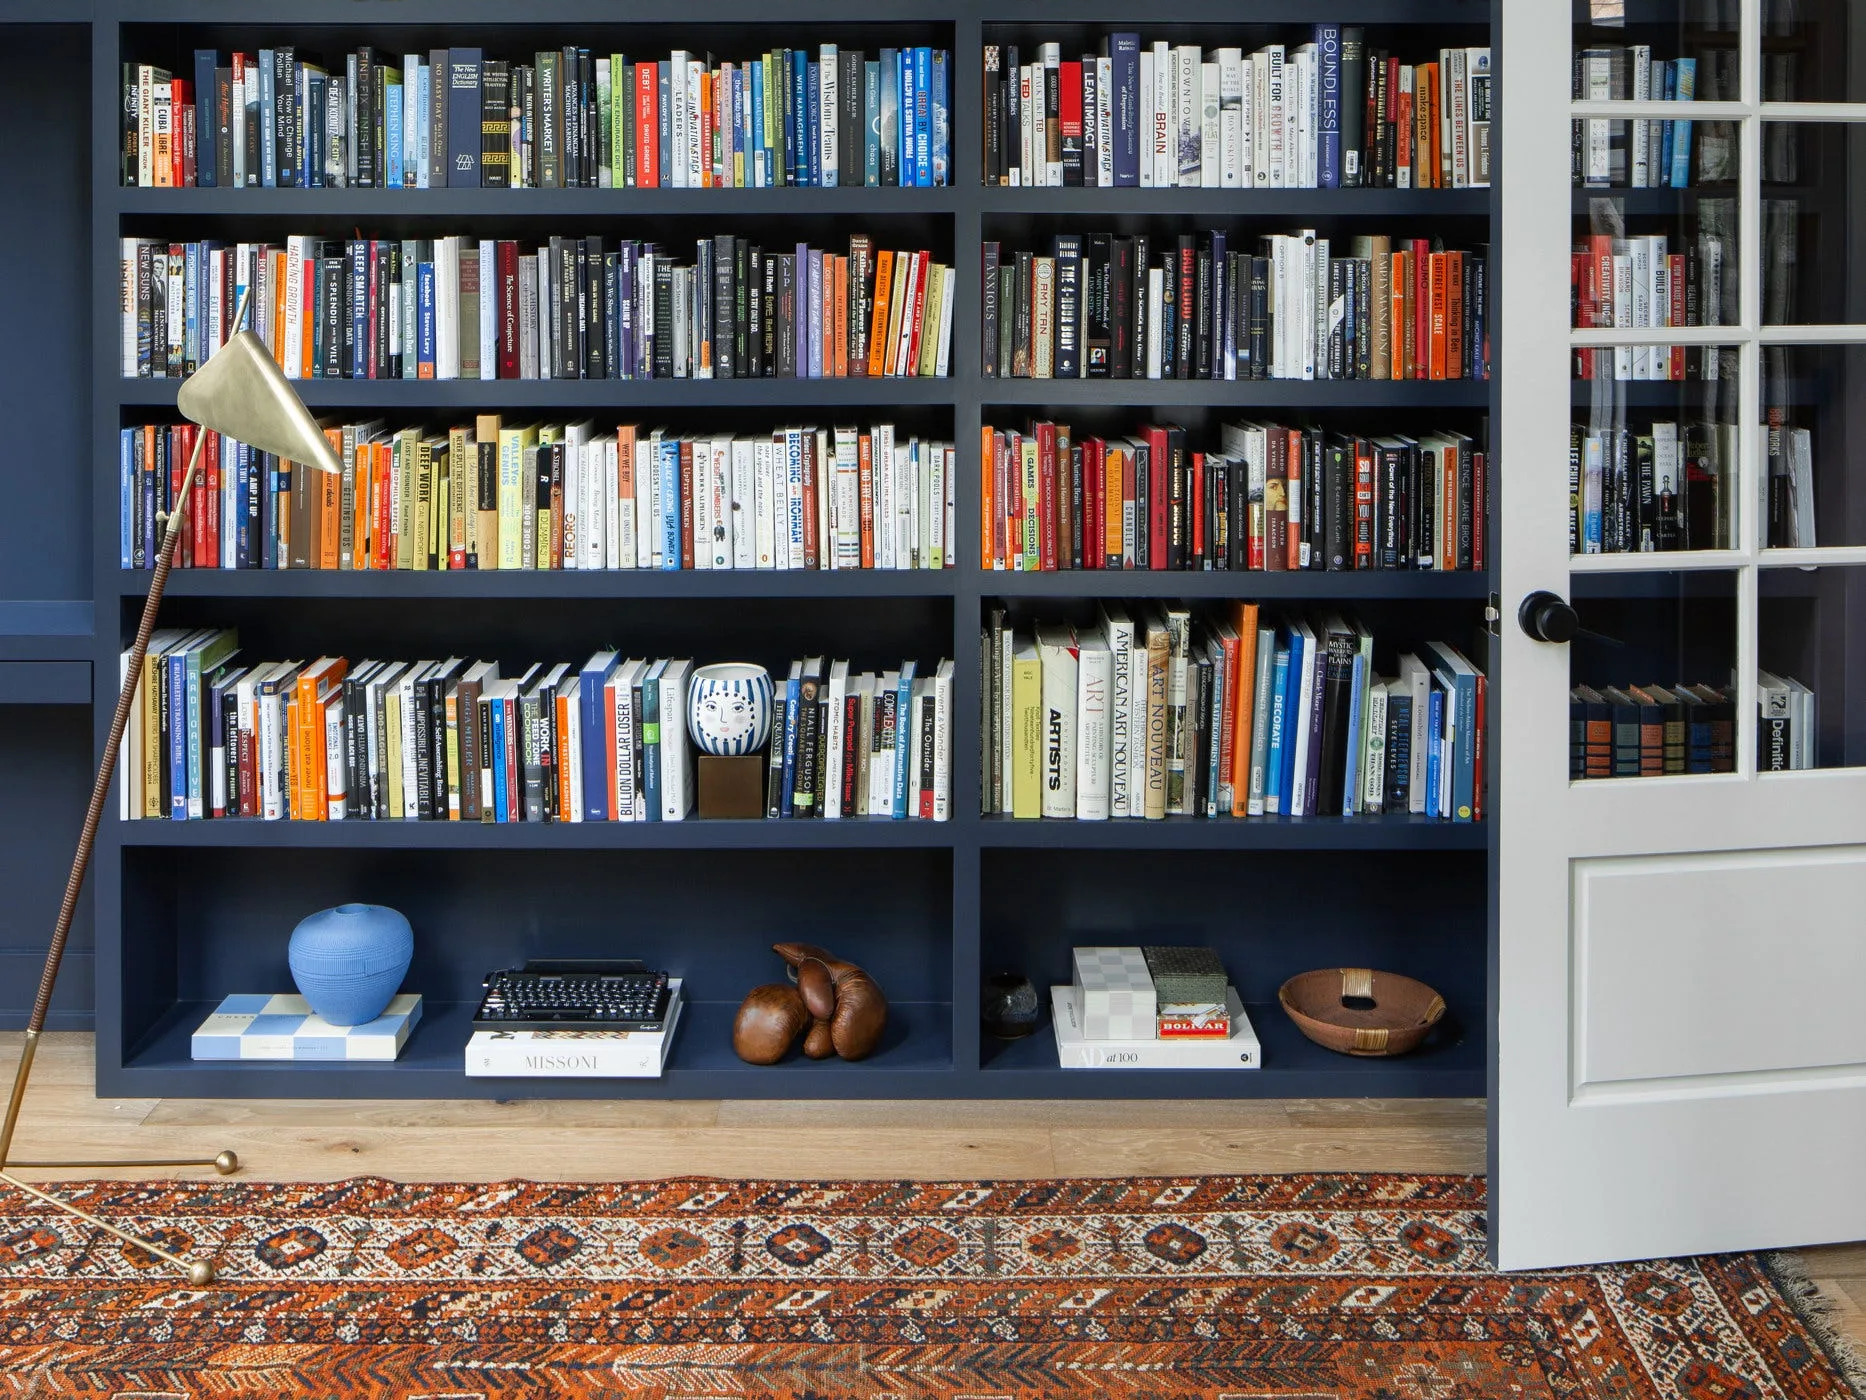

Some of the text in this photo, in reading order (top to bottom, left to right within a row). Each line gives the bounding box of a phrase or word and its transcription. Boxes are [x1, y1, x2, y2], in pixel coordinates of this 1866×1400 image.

[276, 53, 293, 86] Michael Pollan
[642, 68, 650, 90] DEBT
[1272, 52, 1281, 101] BUILT FOR
[1323, 29, 1336, 129] BOUNDLESS
[277, 94, 285, 137] Your Mind
[286, 116, 293, 124] to
[390, 89, 399, 157] STEPHEN KING
[543, 68, 552, 153] WRITER'S MARKET
[1022, 78, 1030, 126] TED TALKS
[1084, 72, 1095, 149] LEAN IMPACT
[1416, 86, 1427, 141] make space
[159, 109, 172, 154] CUBA LIBRE
[285, 126, 293, 158] Change
[1156, 112, 1166, 154] BRAIN
[141, 247, 150, 300] NEW SUNS
[506, 286, 514, 308] Science
[606, 272, 614, 286] Why
[607, 288, 614, 298] We
[986, 264, 995, 320] ANXIOUS
[1600, 256, 1610, 301] CREATIVITY,
[1656, 270, 1665, 293] BUILD
[1040, 283, 1049, 335] AMY TAN
[1434, 314, 1442, 334] SCALE
[423, 338, 431, 354] Levy
[506, 318, 514, 352] Conjecture
[419, 447, 430, 470] DEEP
[1641, 460, 1652, 504] THE PAWN
[250, 506, 257, 516] UP
[419, 474, 430, 502] WORK
[789, 433, 802, 543] BECOMING IRONMAN
[1462, 451, 1470, 548] SILENCE JANE BROX
[1028, 508, 1036, 555] DECISIONS
[1085, 673, 1105, 717] ART
[524, 703, 532, 765] COOKBOOK
[539, 718, 550, 766] WORK IN
[774, 704, 784, 755] THE QUANTS
[1114, 629, 1129, 810] AMERICAN ART NOUVEAU
[1150, 667, 1164, 790] ART NOUVEAU
[1271, 695, 1283, 748] DECORATE
[416, 710, 429, 805] IMPOSSIBLE INEVITABLE
[617, 704, 632, 816] BILLION DOLLAR LOSER
[923, 718, 932, 772] The Outsider
[1049, 709, 1061, 791] ARTISTS
[526, 1056, 598, 1070] MISSONI
[1107, 1054, 1116, 1062] at
[1119, 1053, 1138, 1062] 100
